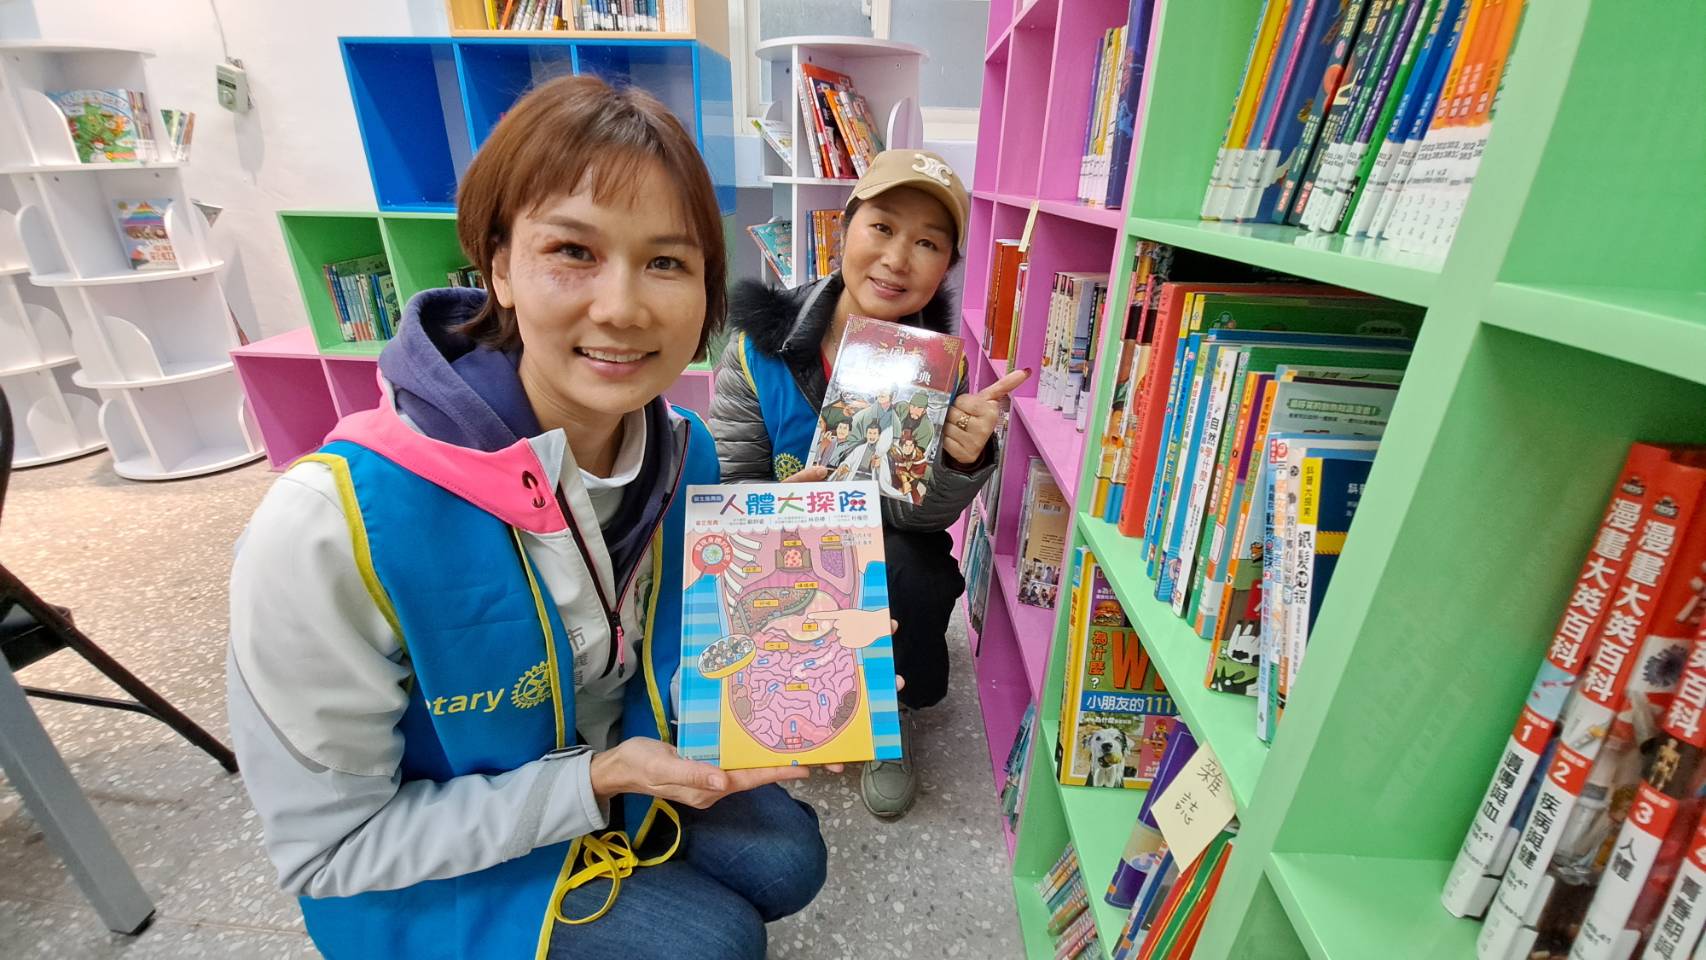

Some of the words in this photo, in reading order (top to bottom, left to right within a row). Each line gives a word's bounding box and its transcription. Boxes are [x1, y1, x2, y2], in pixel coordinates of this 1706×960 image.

[720, 490, 867, 516] 人體大探險
[1550, 498, 1642, 669] 漫畫大英百科
[1584, 519, 1676, 702] 漫畫大英百科
[1112, 631, 1166, 691] W
[426, 688, 504, 715] tary
[1087, 694, 1177, 714] 小朋友的111
[1521, 724, 1533, 742] 1
[1552, 763, 1570, 783] 2
[1634, 801, 1654, 824] 3
[1612, 838, 1637, 881] 人體
